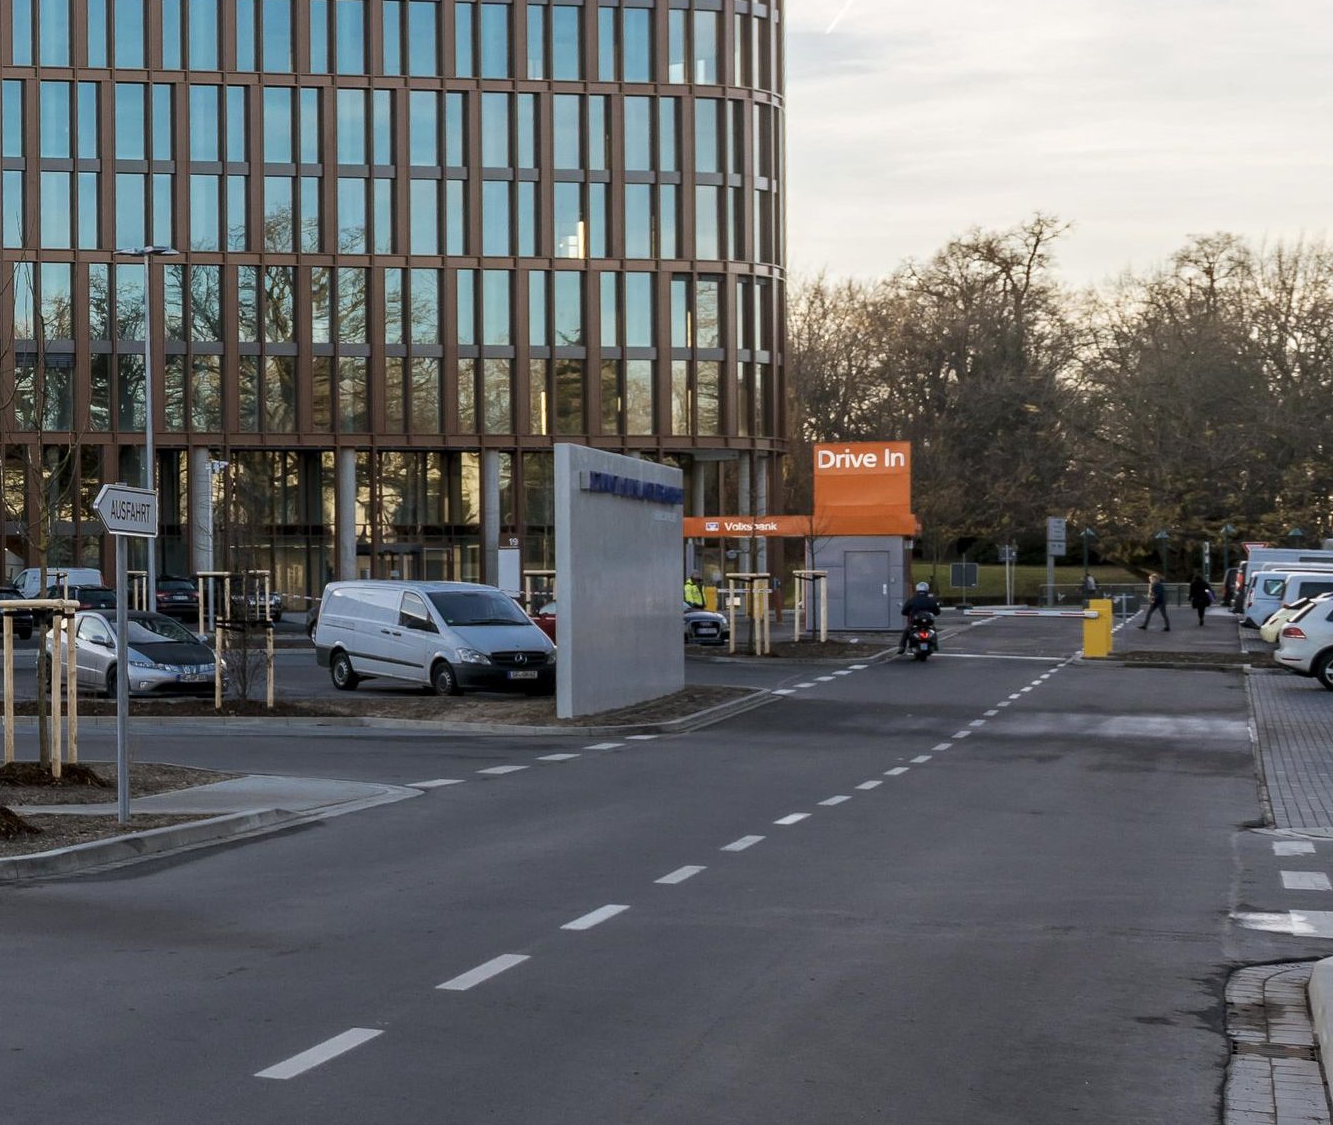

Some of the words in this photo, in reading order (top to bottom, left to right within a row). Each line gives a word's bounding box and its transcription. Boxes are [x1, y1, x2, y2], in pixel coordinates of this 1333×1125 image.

[818, 448, 878, 469] Drive
[884, 448, 905, 468] In
[110, 499, 151, 524] AUSFAHRT
